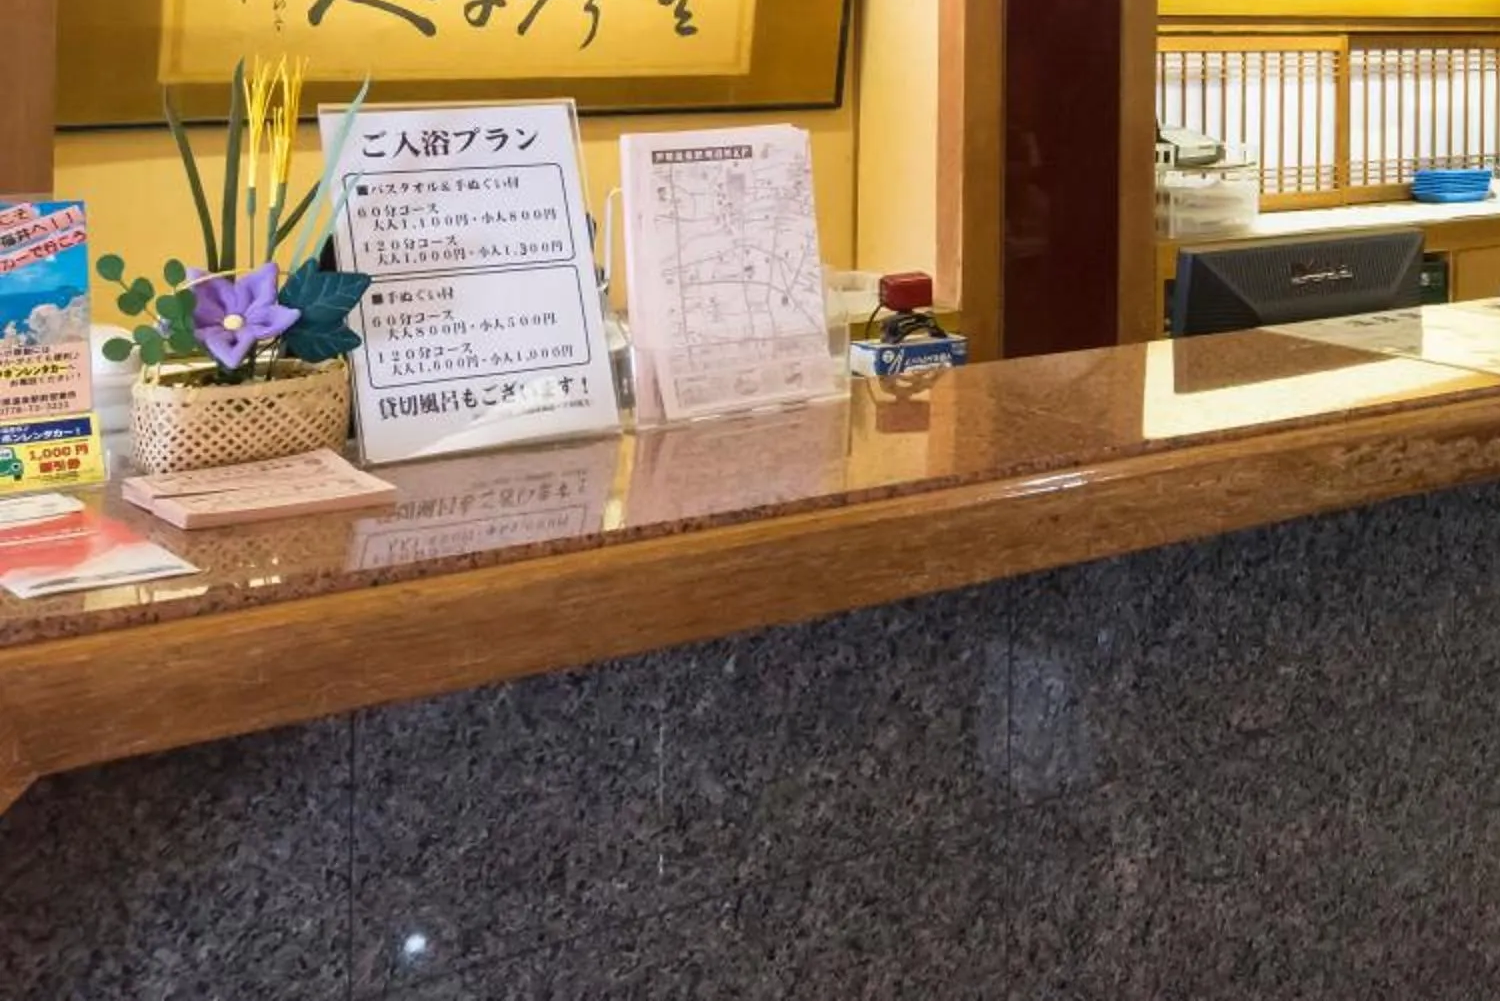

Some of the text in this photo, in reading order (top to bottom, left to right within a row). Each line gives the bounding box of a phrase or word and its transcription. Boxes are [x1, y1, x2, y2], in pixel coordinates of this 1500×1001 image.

[362, 126, 540, 158] ご入浴プラン
